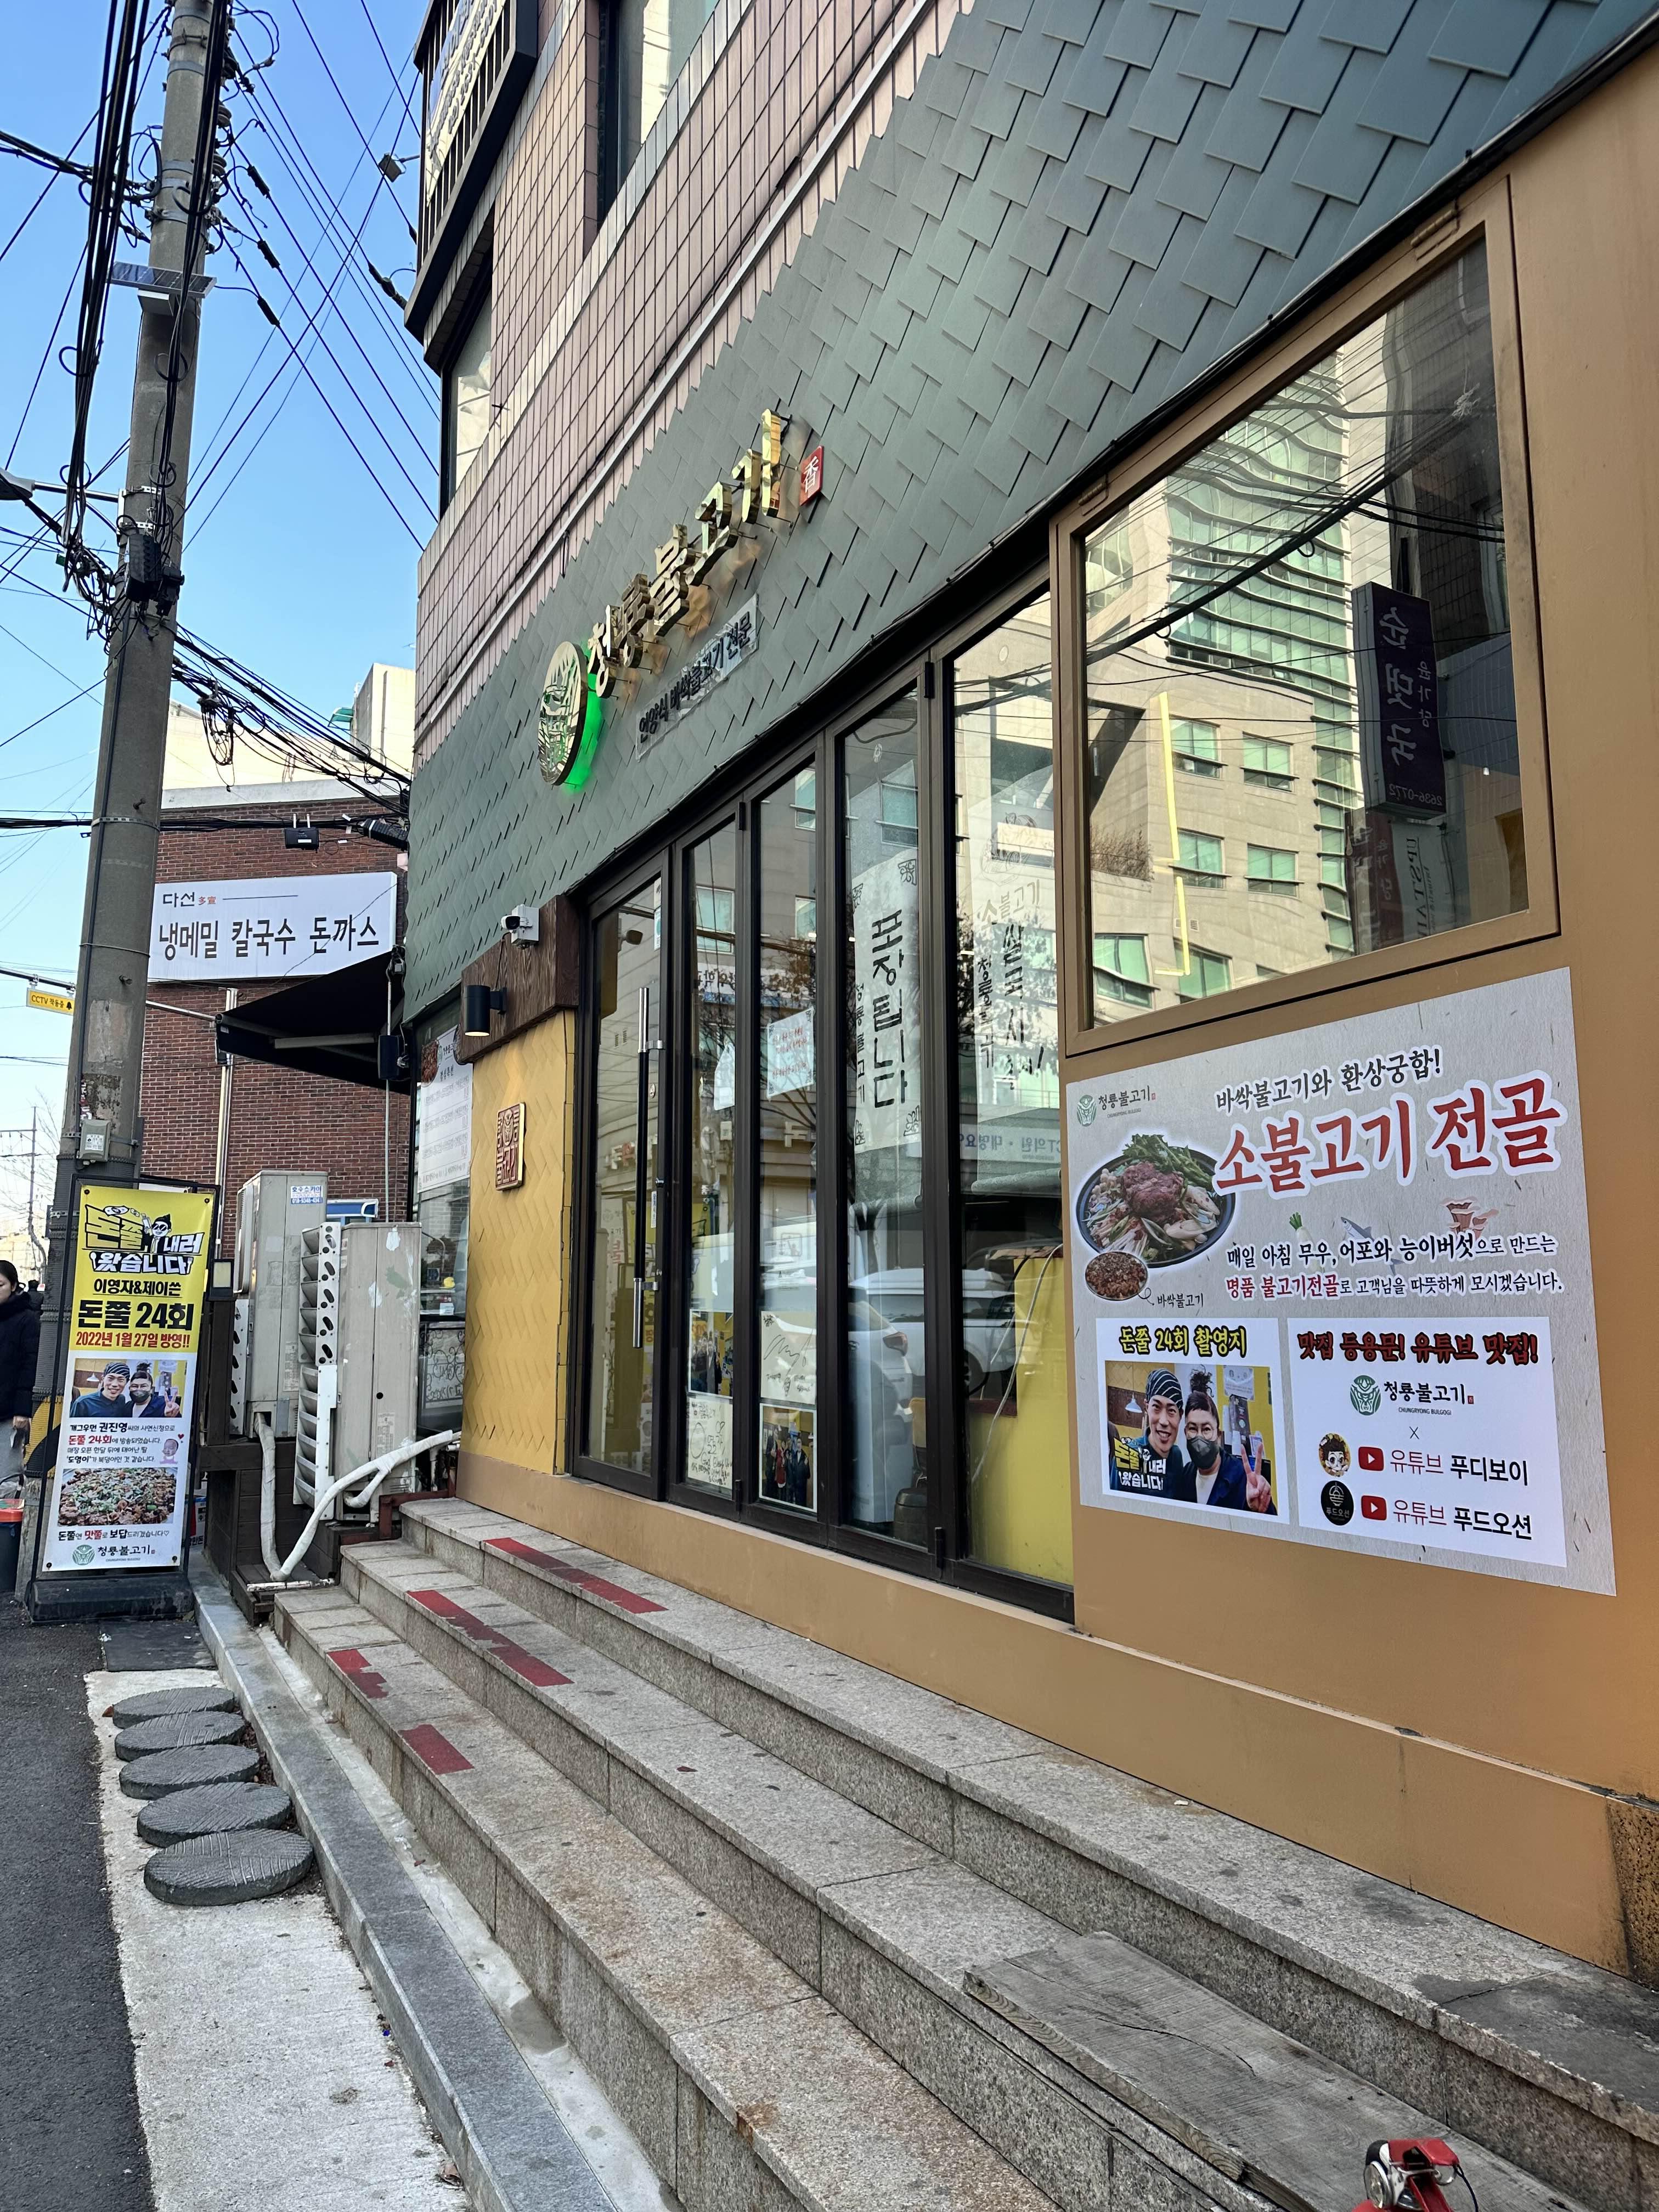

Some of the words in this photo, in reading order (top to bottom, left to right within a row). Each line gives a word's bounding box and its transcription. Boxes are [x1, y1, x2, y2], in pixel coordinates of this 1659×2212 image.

[803, 456, 820, 497] 香
[668, 636, 724, 711] 바싹불고기
[725, 611, 752, 661] 전문
[163, 891, 195, 907] 다선
[159, 920, 219, 961] 냉메밀
[232, 918, 296, 957] 칼국수
[309, 914, 379, 953] 돈까스
[31, 995, 48, 1004] CCTV
[49, 998, 64, 1008] 작동중
[1216, 1068, 1332, 1114] 바싹불고기와
[1341, 1048, 1442, 1092] 환상궁합!
[1098, 1085, 1150, 1110] 청룡불고기
[1216, 1099, 1411, 1193] 소불고기
[1431, 1078, 1561, 1172] 전골
[164, 1232, 205, 1254] 내러
[1227, 1245, 1256, 1268] 매일
[1262, 1243, 1291, 1267] 아침
[1298, 1242, 1336, 1265] 무우,
[1340, 1238, 1392, 1264] 어포와
[1400, 1232, 1505, 1261] 능이버섯으로
[1510, 1234, 1556, 1255] 만드는
[94, 1251, 189, 1274] 왔습니다
[94, 1278, 182, 1296] 이영자&제이쓴
[1226, 1277, 1255, 1299] 명품
[1261, 1273, 1352, 1299] 불고기전골로
[1357, 1277, 1406, 1295] 고객님을
[1410, 1274, 1464, 1294] 따뜻하게
[1470, 1271, 1563, 1293] 모시겠습니다.
[1158, 1293, 1204, 1308] 바싹불고기
[78, 1299, 132, 1329] 돈쭐
[135, 1302, 195, 1331] 24회
[76, 1331, 113, 1347] 2022년
[115, 1332, 133, 1348] 1월
[133, 1333, 159, 1348] 27일
[160, 1333, 190, 1349] 방영!!
[1119, 1325, 1152, 1355] 돈쭐
[1154, 1325, 1190, 1356] 24회
[1193, 1325, 1247, 1358] 촬영지
[1297, 1331, 1334, 1361] 맛집
[1340, 1331, 1406, 1362] 등용문!
[1410, 1331, 1479, 1363] 유튜브
[1482, 1332, 1539, 1365] 맛집!
[1384, 1381, 1465, 1405] 청룡불고기
[88, 1435, 119, 1444] 24회에
[99, 1422, 139, 1433] 권진영씨의
[1149, 1458, 1167, 1474] 내러
[1390, 1450, 1444, 1475] 유튜브
[1450, 1455, 1528, 1486] 푸디보이
[1121, 1472, 1164, 1491] 왔습니다
[1326, 1507, 1350, 1518] 푸드오션
[1393, 1500, 1447, 1526] 유튜브
[1454, 1507, 1532, 1541] 푸드오션
[97, 1544, 150, 1557] 청룡불고기
